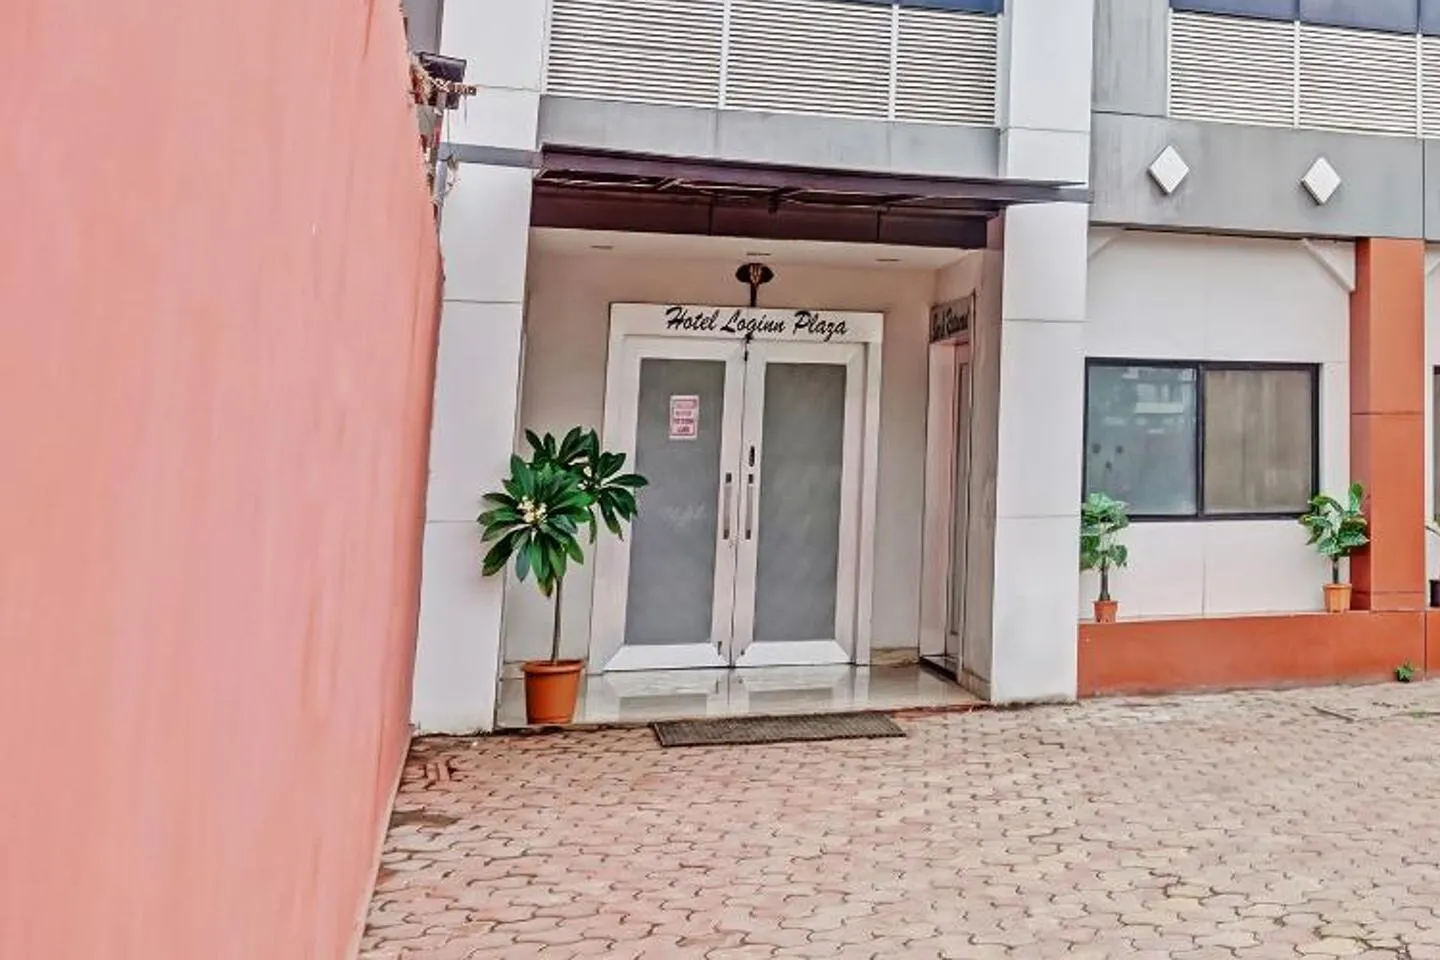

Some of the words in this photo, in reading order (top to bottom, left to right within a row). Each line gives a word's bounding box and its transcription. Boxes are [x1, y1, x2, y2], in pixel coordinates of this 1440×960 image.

[665, 306, 720, 331] Hotel
[720, 309, 786, 334] Loginn
[793, 310, 847, 342] Plaza
